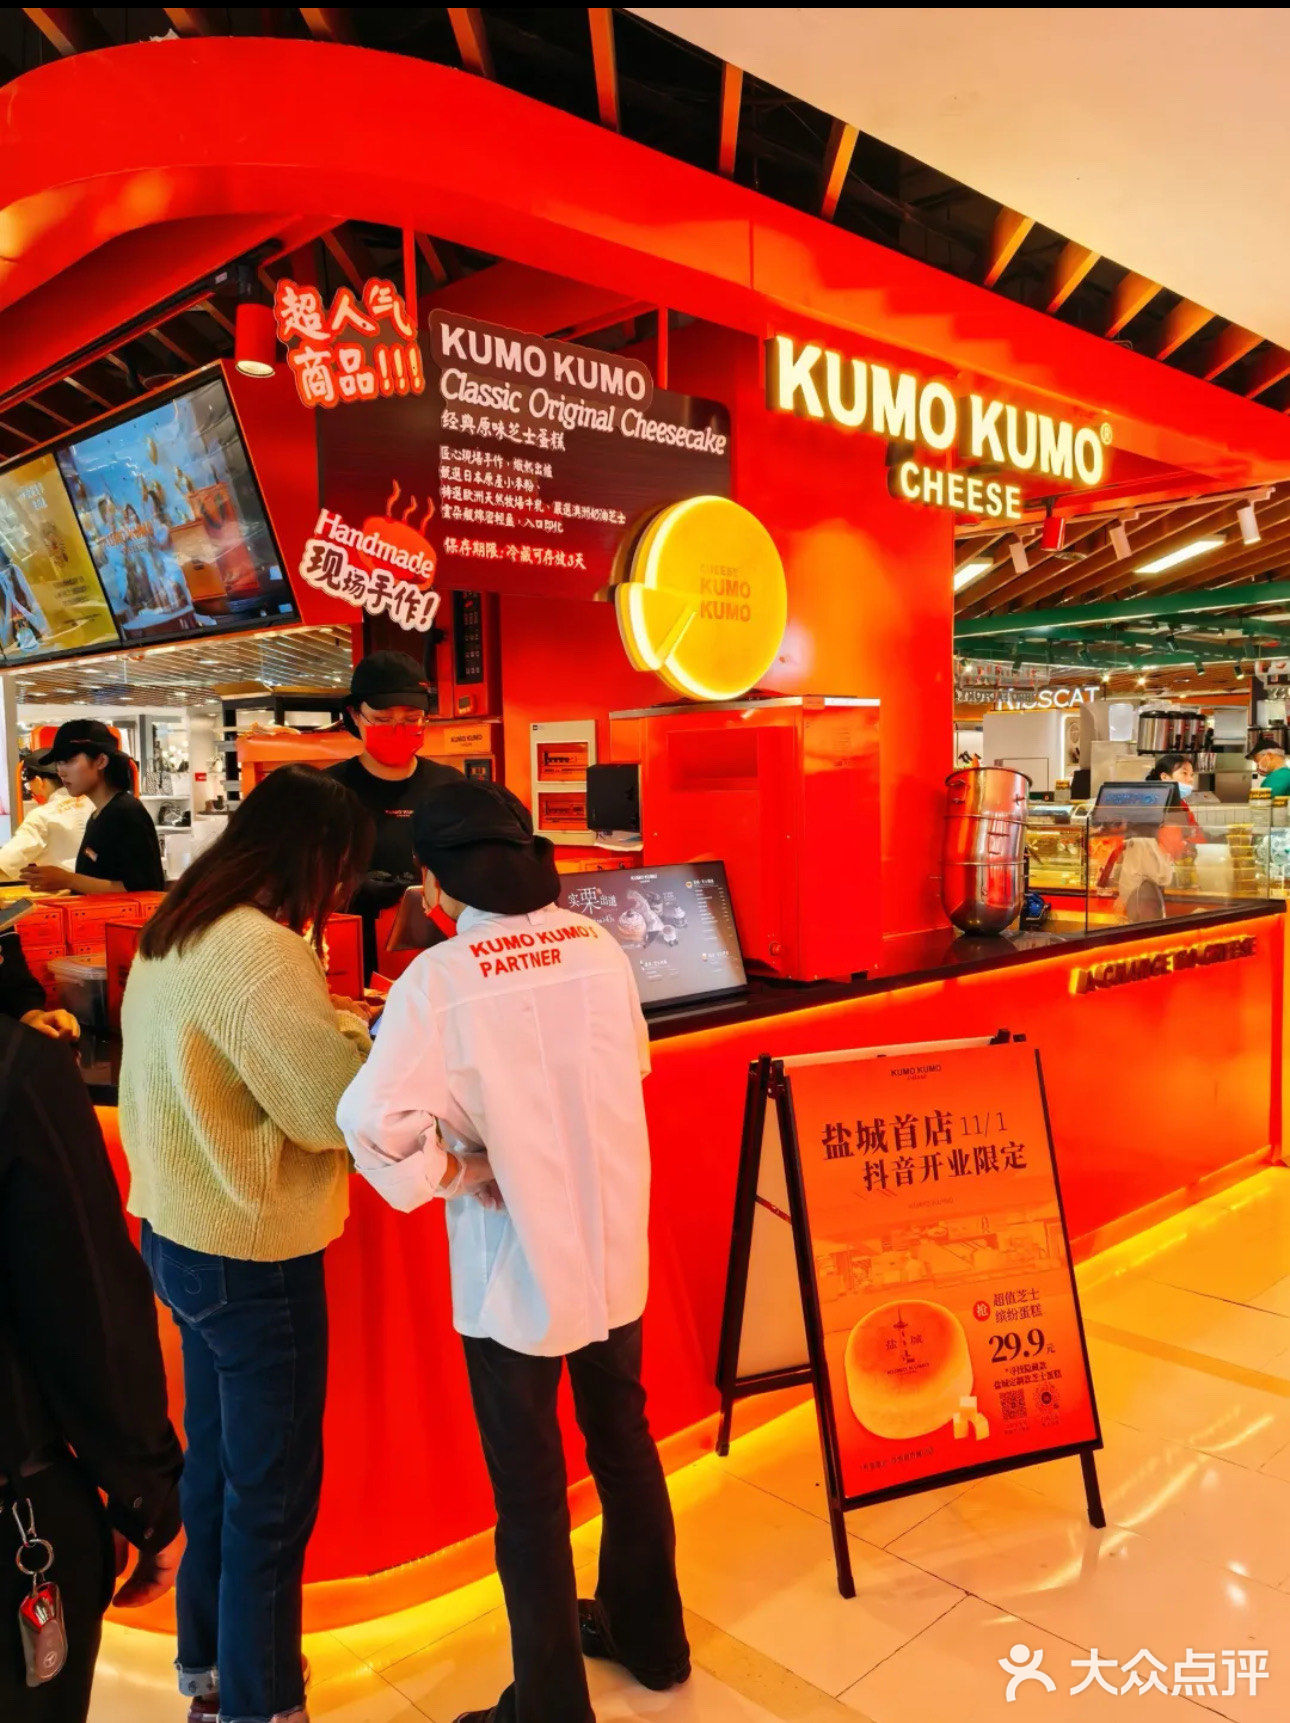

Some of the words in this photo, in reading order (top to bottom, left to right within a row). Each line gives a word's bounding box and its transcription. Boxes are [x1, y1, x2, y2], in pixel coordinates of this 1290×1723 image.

[281, 286, 412, 340] 超人气
[440, 323, 547, 378] KUMO
[553, 351, 646, 401] KUMO
[440, 368, 523, 414] Classic
[529, 388, 614, 432] Original
[621, 408, 727, 455] Cheesecake
[777, 335, 957, 449] KUMO
[441, 409, 566, 451] 经典原味芝士蛋糕
[900, 461, 1022, 519] CHEESE
[314, 508, 434, 579] Handmade
[700, 578, 751, 599] KUMO
[700, 600, 751, 622] KUMO
[469, 933, 535, 958] KUMO
[479, 948, 562, 978] PARTNER
[890, 1066, 916, 1077] KUMO
[917, 1064, 942, 1075] KUMO
[821, 1109, 953, 1161] 盐城首店
[863, 1141, 1028, 1192] 抖音开业限定
[993, 1288, 1040, 1307] 超值芝士
[988, 1327, 1046, 1364] 29.9
